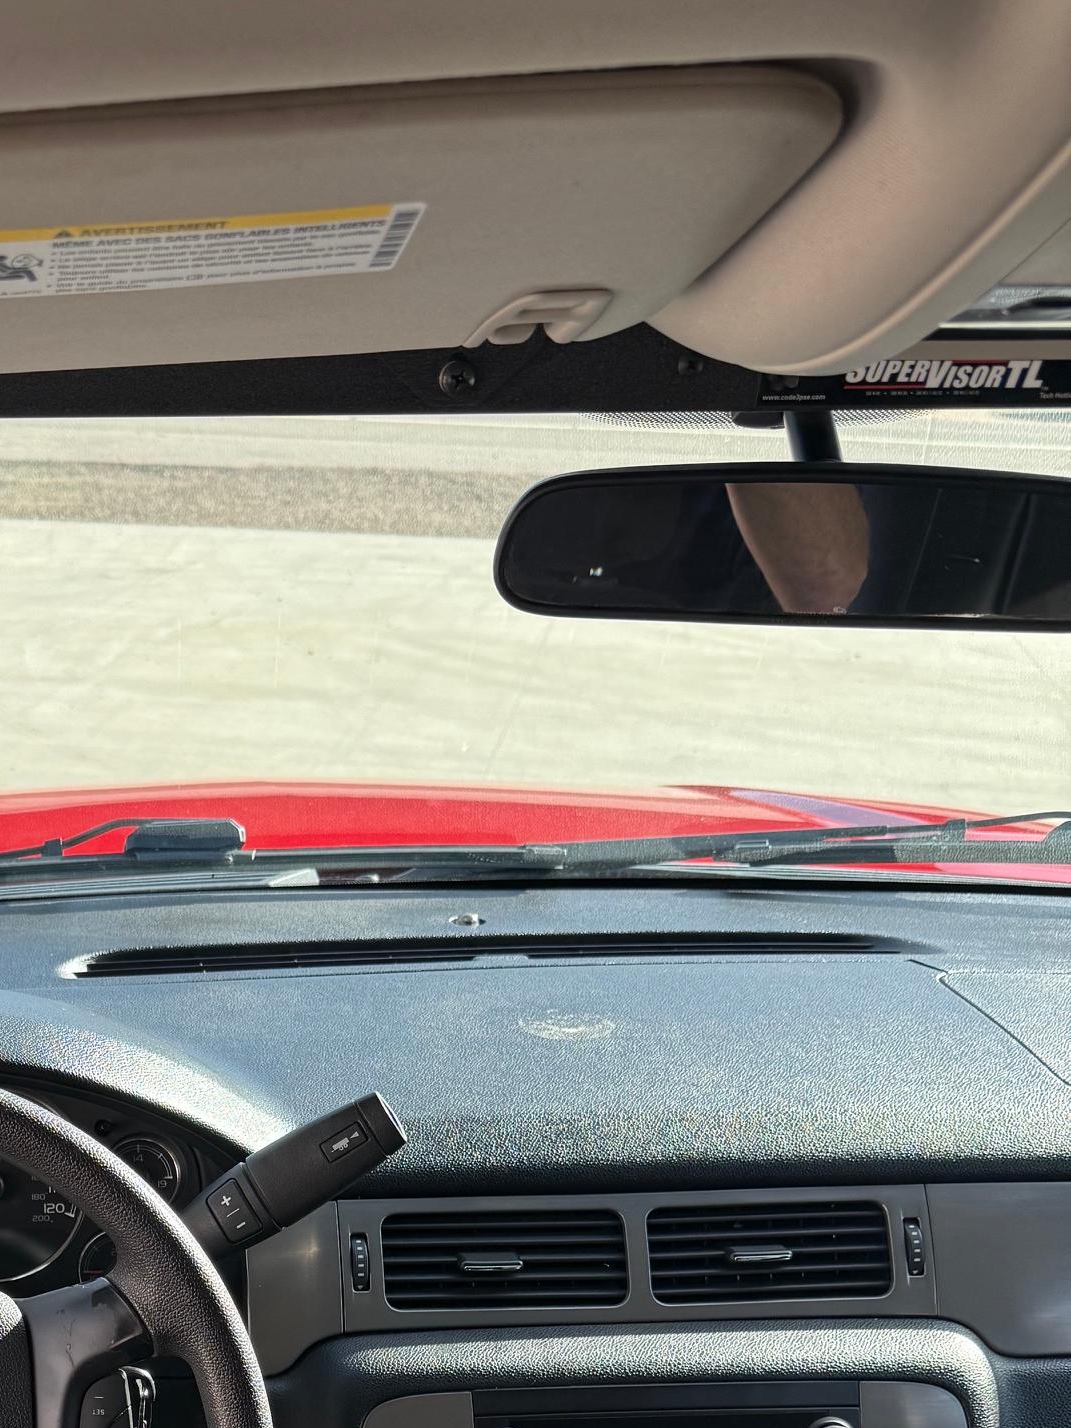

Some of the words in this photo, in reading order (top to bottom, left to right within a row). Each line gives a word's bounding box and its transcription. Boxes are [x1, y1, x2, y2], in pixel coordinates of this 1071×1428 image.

[97, 238, 131, 247] AVEC
[135, 236, 161, 245] DES
[165, 234, 201, 243] SACS
[132, 1154, 144, 1163] 14
[157, 1180, 167, 1188] 19
[43, 1202, 65, 1214] 120
